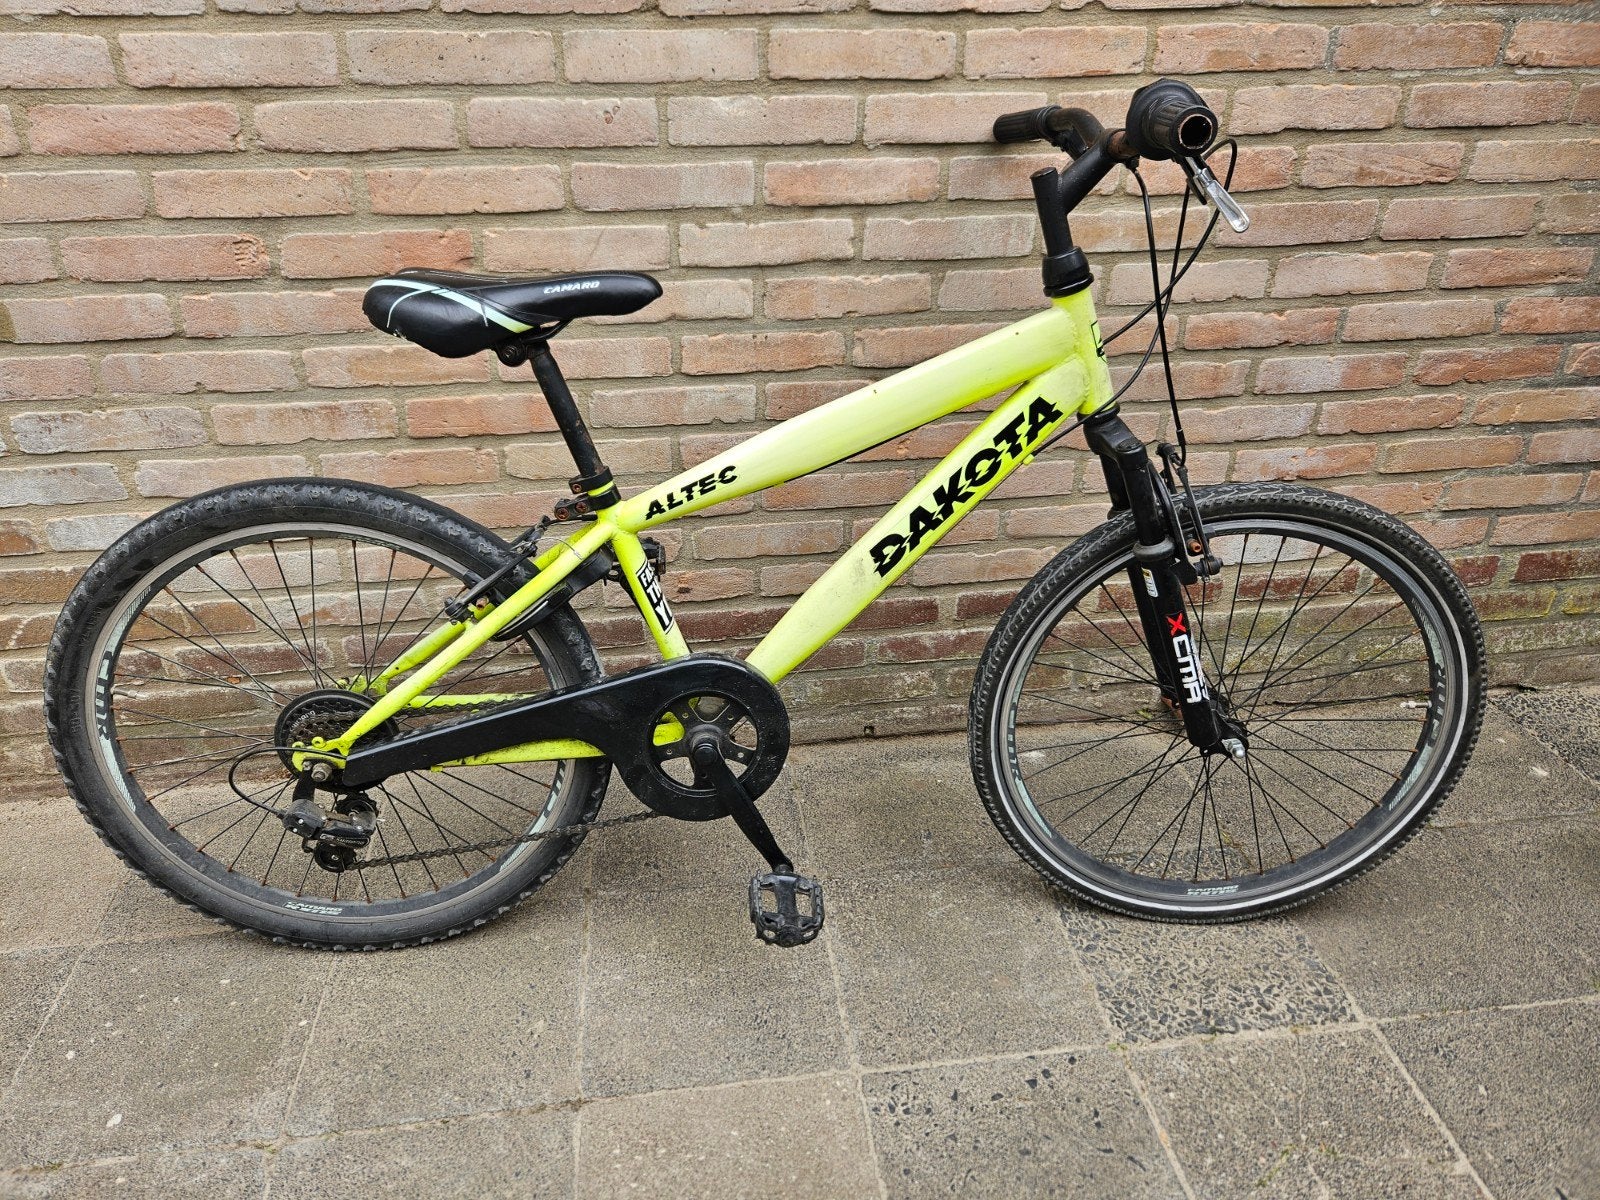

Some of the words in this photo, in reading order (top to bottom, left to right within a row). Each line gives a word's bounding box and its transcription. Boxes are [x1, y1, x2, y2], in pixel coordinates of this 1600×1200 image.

[645, 465, 738, 520] ALTEC
[869, 396, 1064, 578] DAKOTA
[1166, 612, 1202, 704] XCMA
